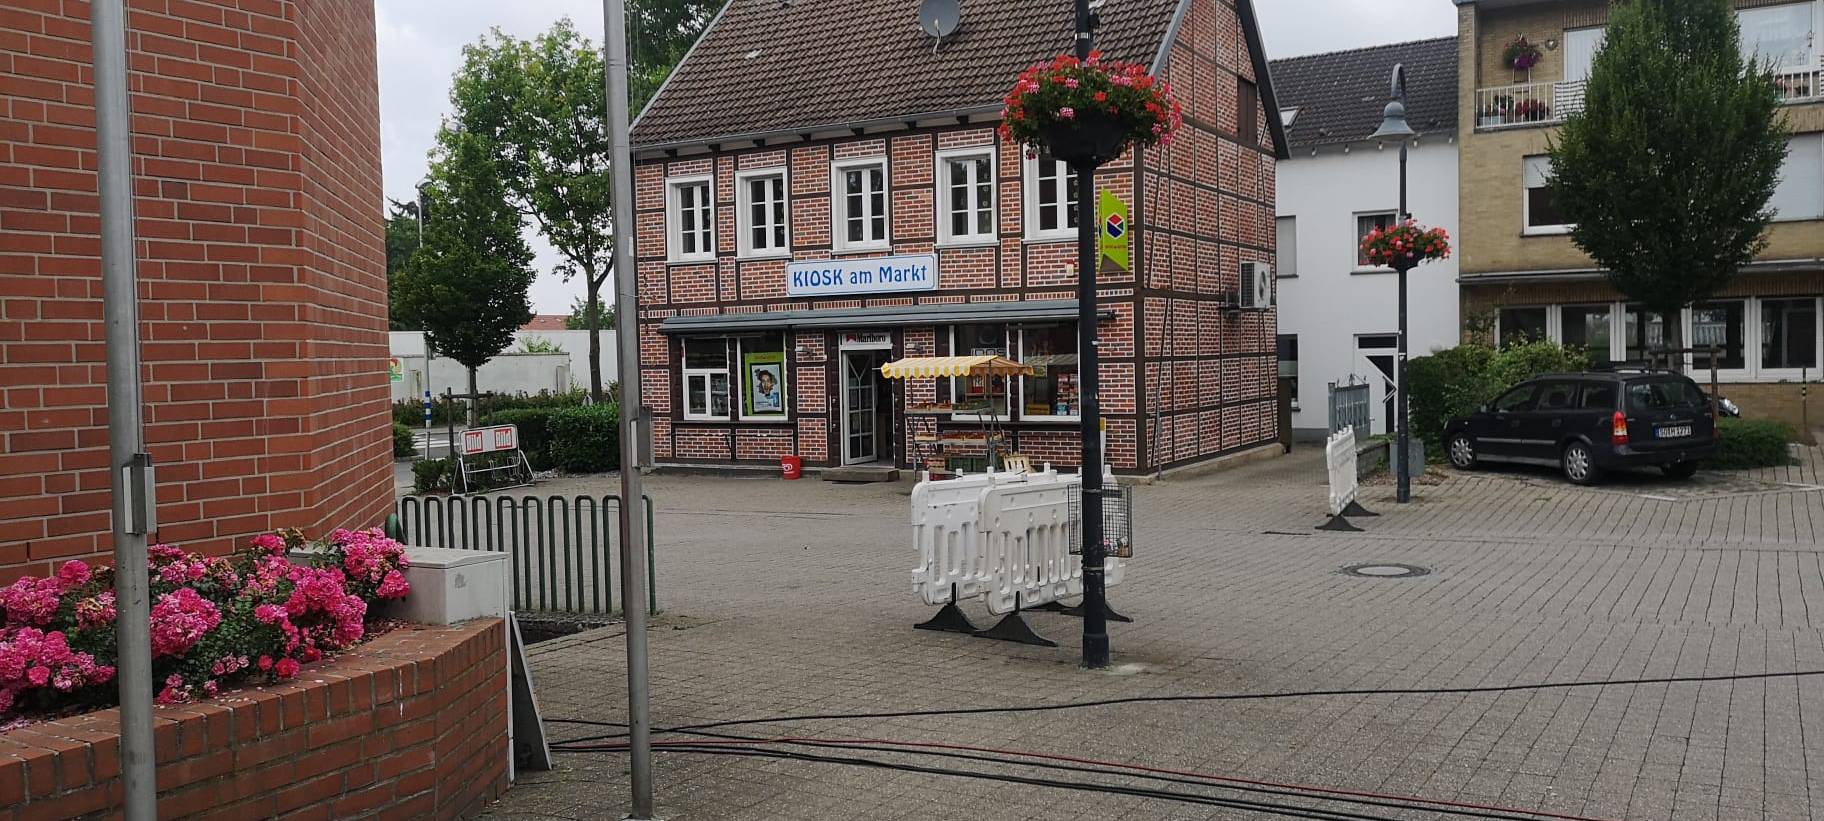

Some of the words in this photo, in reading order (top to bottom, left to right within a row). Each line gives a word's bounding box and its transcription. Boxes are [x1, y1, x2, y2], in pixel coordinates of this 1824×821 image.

[793, 268, 843, 288] KIOSK
[850, 270, 873, 285] am
[879, 264, 928, 284] Markt
[856, 332, 887, 344] Marlboro
